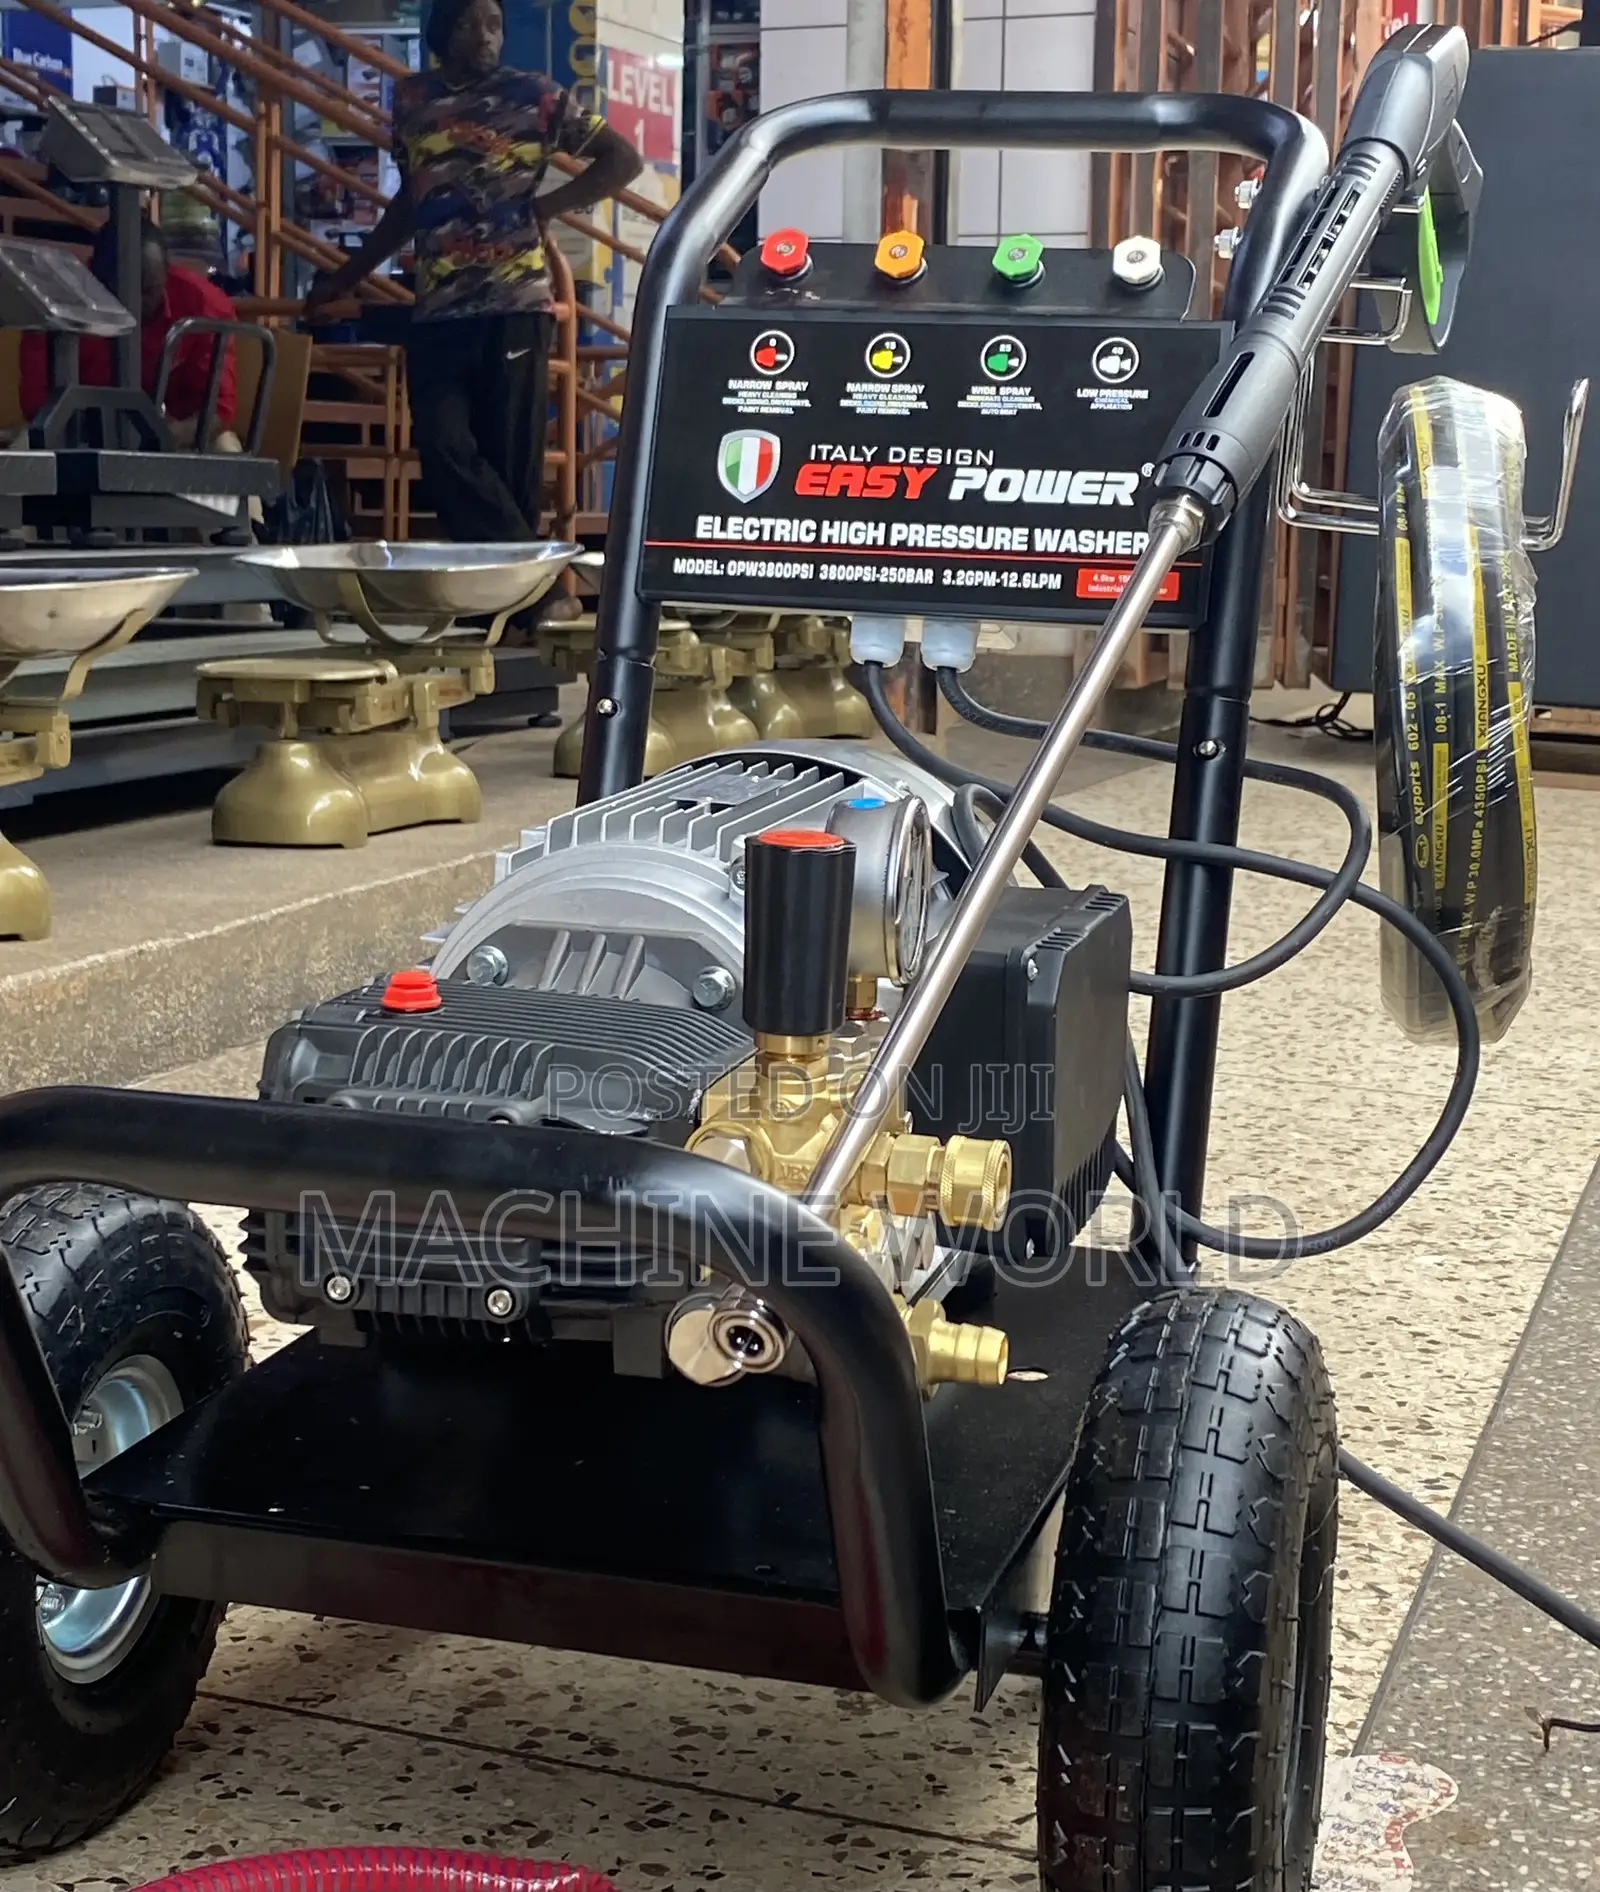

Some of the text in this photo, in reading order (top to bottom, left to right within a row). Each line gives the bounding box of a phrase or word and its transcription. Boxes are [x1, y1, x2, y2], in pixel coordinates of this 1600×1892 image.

[607, 60, 674, 116] LEVEL
[634, 119, 645, 157] 1
[885, 341, 896, 350] 15
[999, 344, 1012, 352] 25
[728, 379, 809, 391] NARROW SPRAY
[846, 382, 925, 394] NARROW SPRAY
[971, 386, 1032, 395] WIDE SPRAY
[1077, 388, 1149, 399] LOW PRESSURE
[809, 444, 994, 466] ITALY DESIGN
[794, 463, 938, 500] EASY
[696, 515, 1149, 555] ELECTRIC HIGH PRESSURE WASHER
[673, 557, 724, 576] MODEL:
[819, 564, 934, 584] 3800PSI-250BAR
[942, 568, 1062, 590] 3.2GPM-12.6LPM
[1504, 614, 1516, 629] IN
[1506, 631, 1519, 672] MADE
[1434, 660, 1446, 694] MAX
[1434, 702, 1448, 733] 08-1
[1476, 664, 1487, 739] XIANGXU
[1409, 761, 1425, 826] exports
[1435, 824, 1445, 886] XIANGXU
[1459, 911, 1473, 938] MAX
[1468, 820, 1484, 878] 30.0MPa
